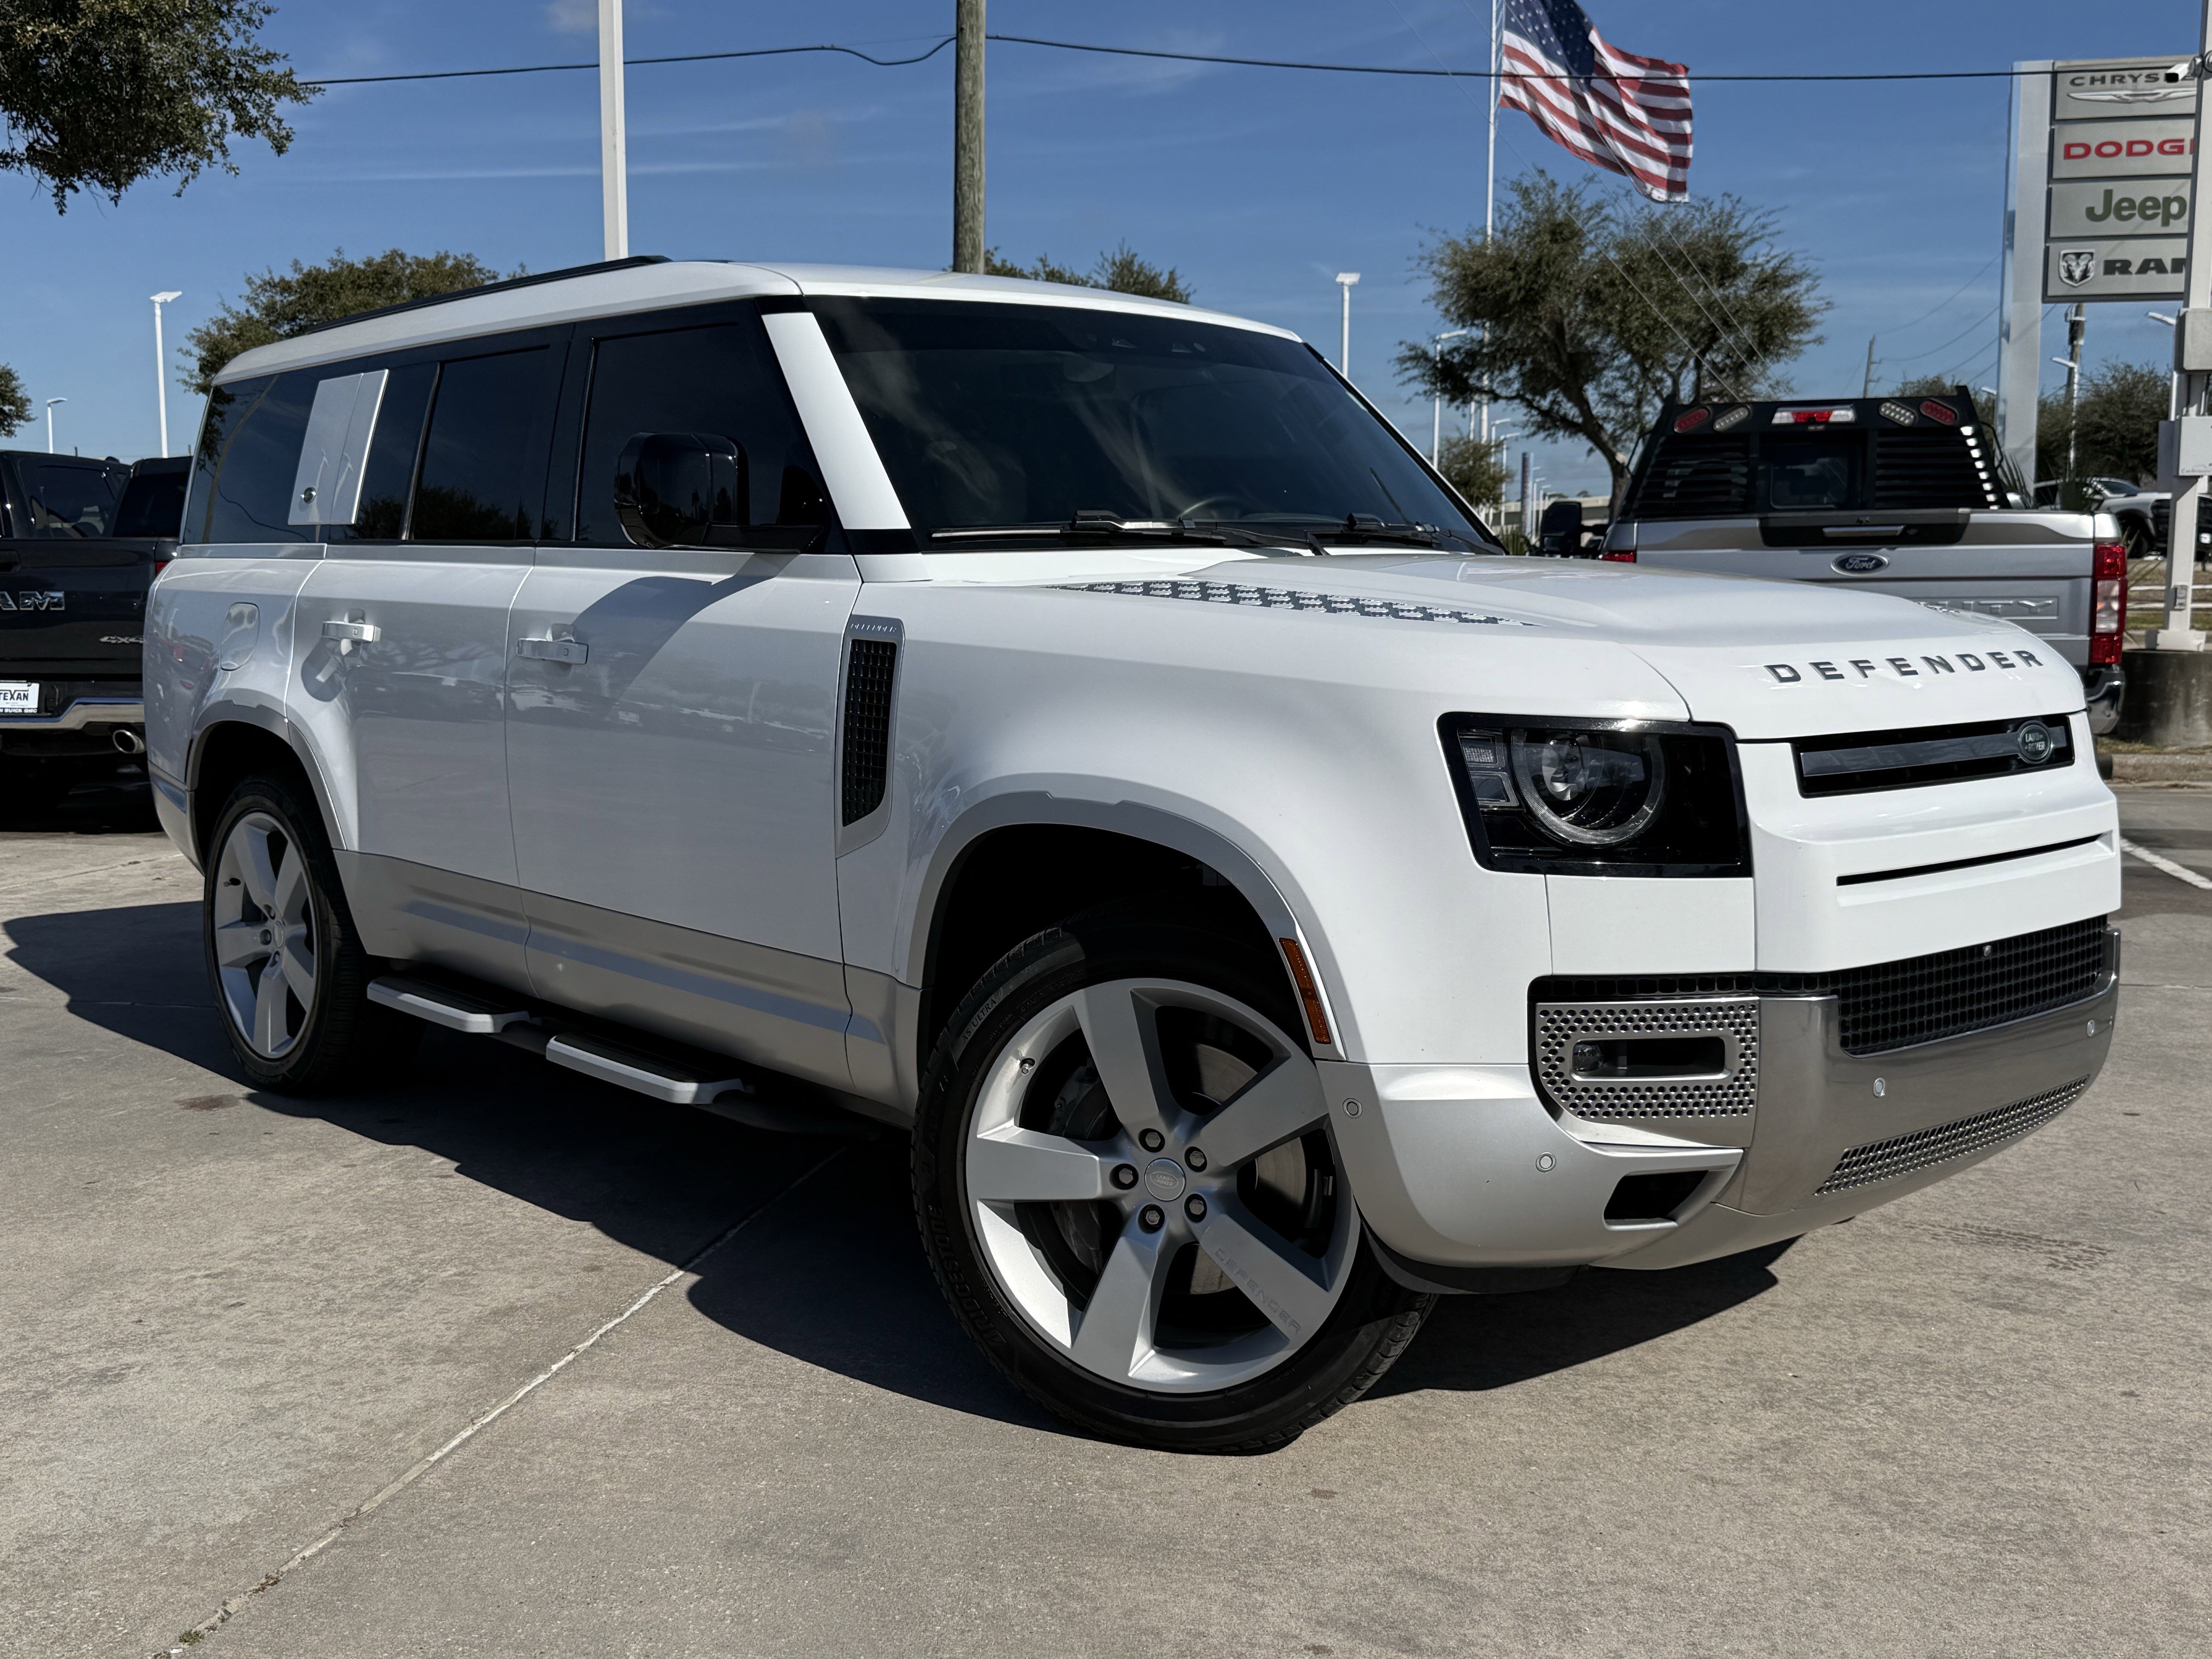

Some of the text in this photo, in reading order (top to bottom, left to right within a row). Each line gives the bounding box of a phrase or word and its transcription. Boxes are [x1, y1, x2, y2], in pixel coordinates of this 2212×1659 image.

[2064, 138, 2194, 160] DODG
[2085, 189, 2187, 227] Jeep
[1846, 557, 1876, 569] Ford
[0, 591, 65, 610] AM
[1764, 650, 2043, 683] DEFENDER
[972, 998, 996, 1027] ULTRA
[1216, 1248, 1302, 1334] DEFENDER
